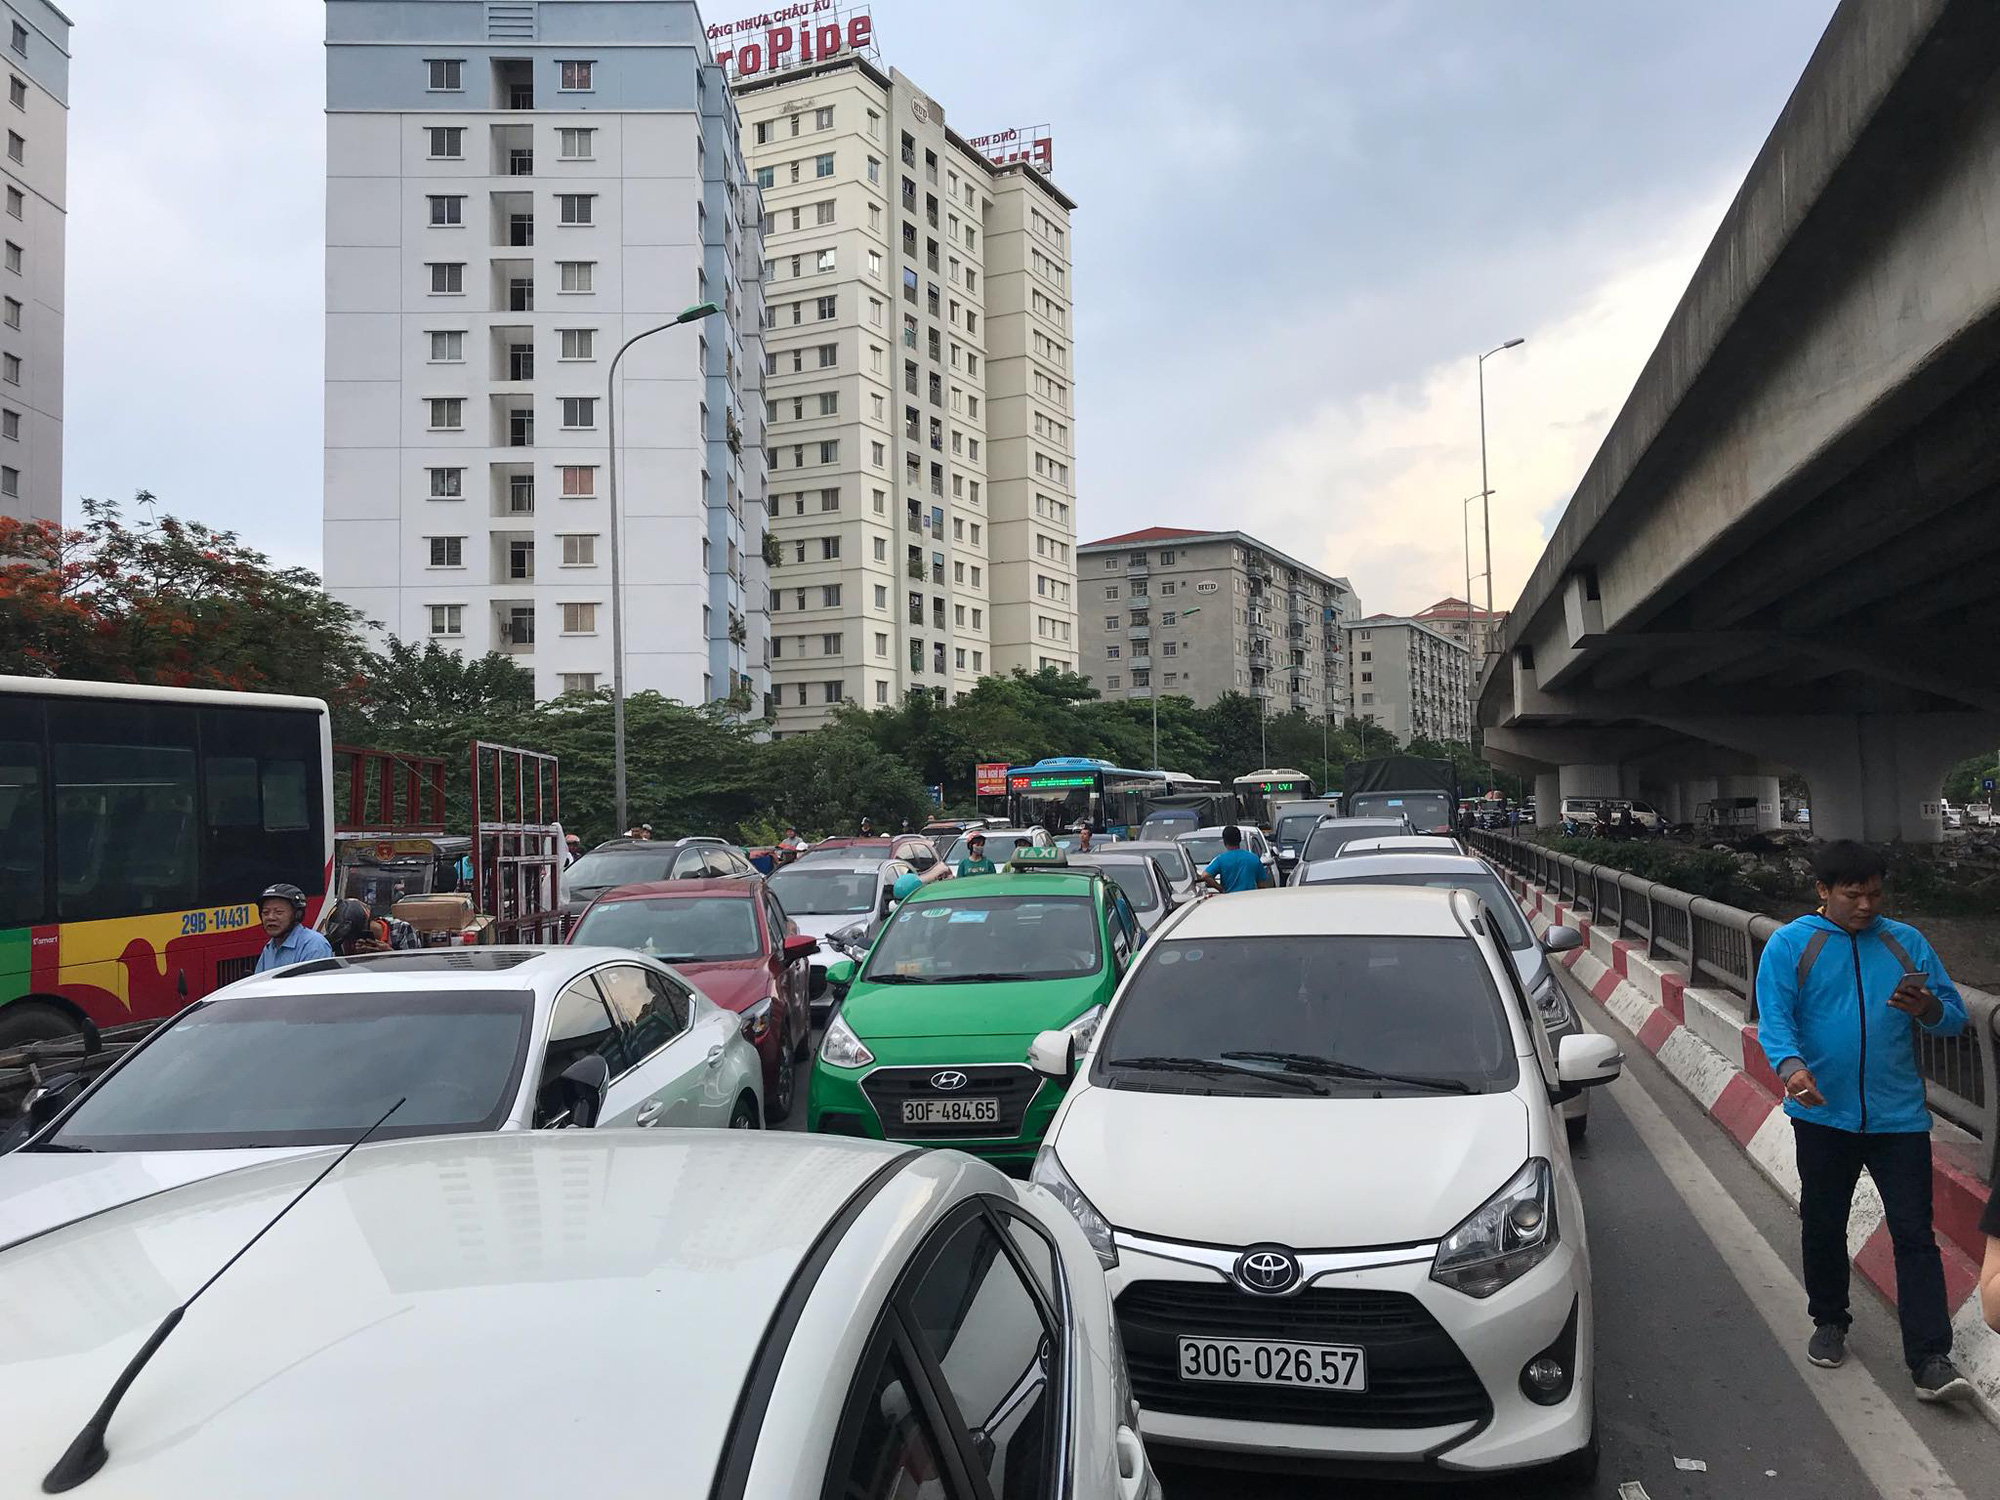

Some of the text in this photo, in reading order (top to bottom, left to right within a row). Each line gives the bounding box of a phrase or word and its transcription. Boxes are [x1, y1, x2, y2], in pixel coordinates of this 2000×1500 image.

[707, 23, 733, 39] ỐNG
[736, 14, 771, 32] NHỰA
[774, 4, 808, 21] CHÂU
[1019, 848, 1057, 858] TAXI
[182, 906, 249, 935] 29B-14431
[905, 1101, 996, 1121] 30F-484.65
[1183, 1343, 1359, 1386] 30G-026.57
